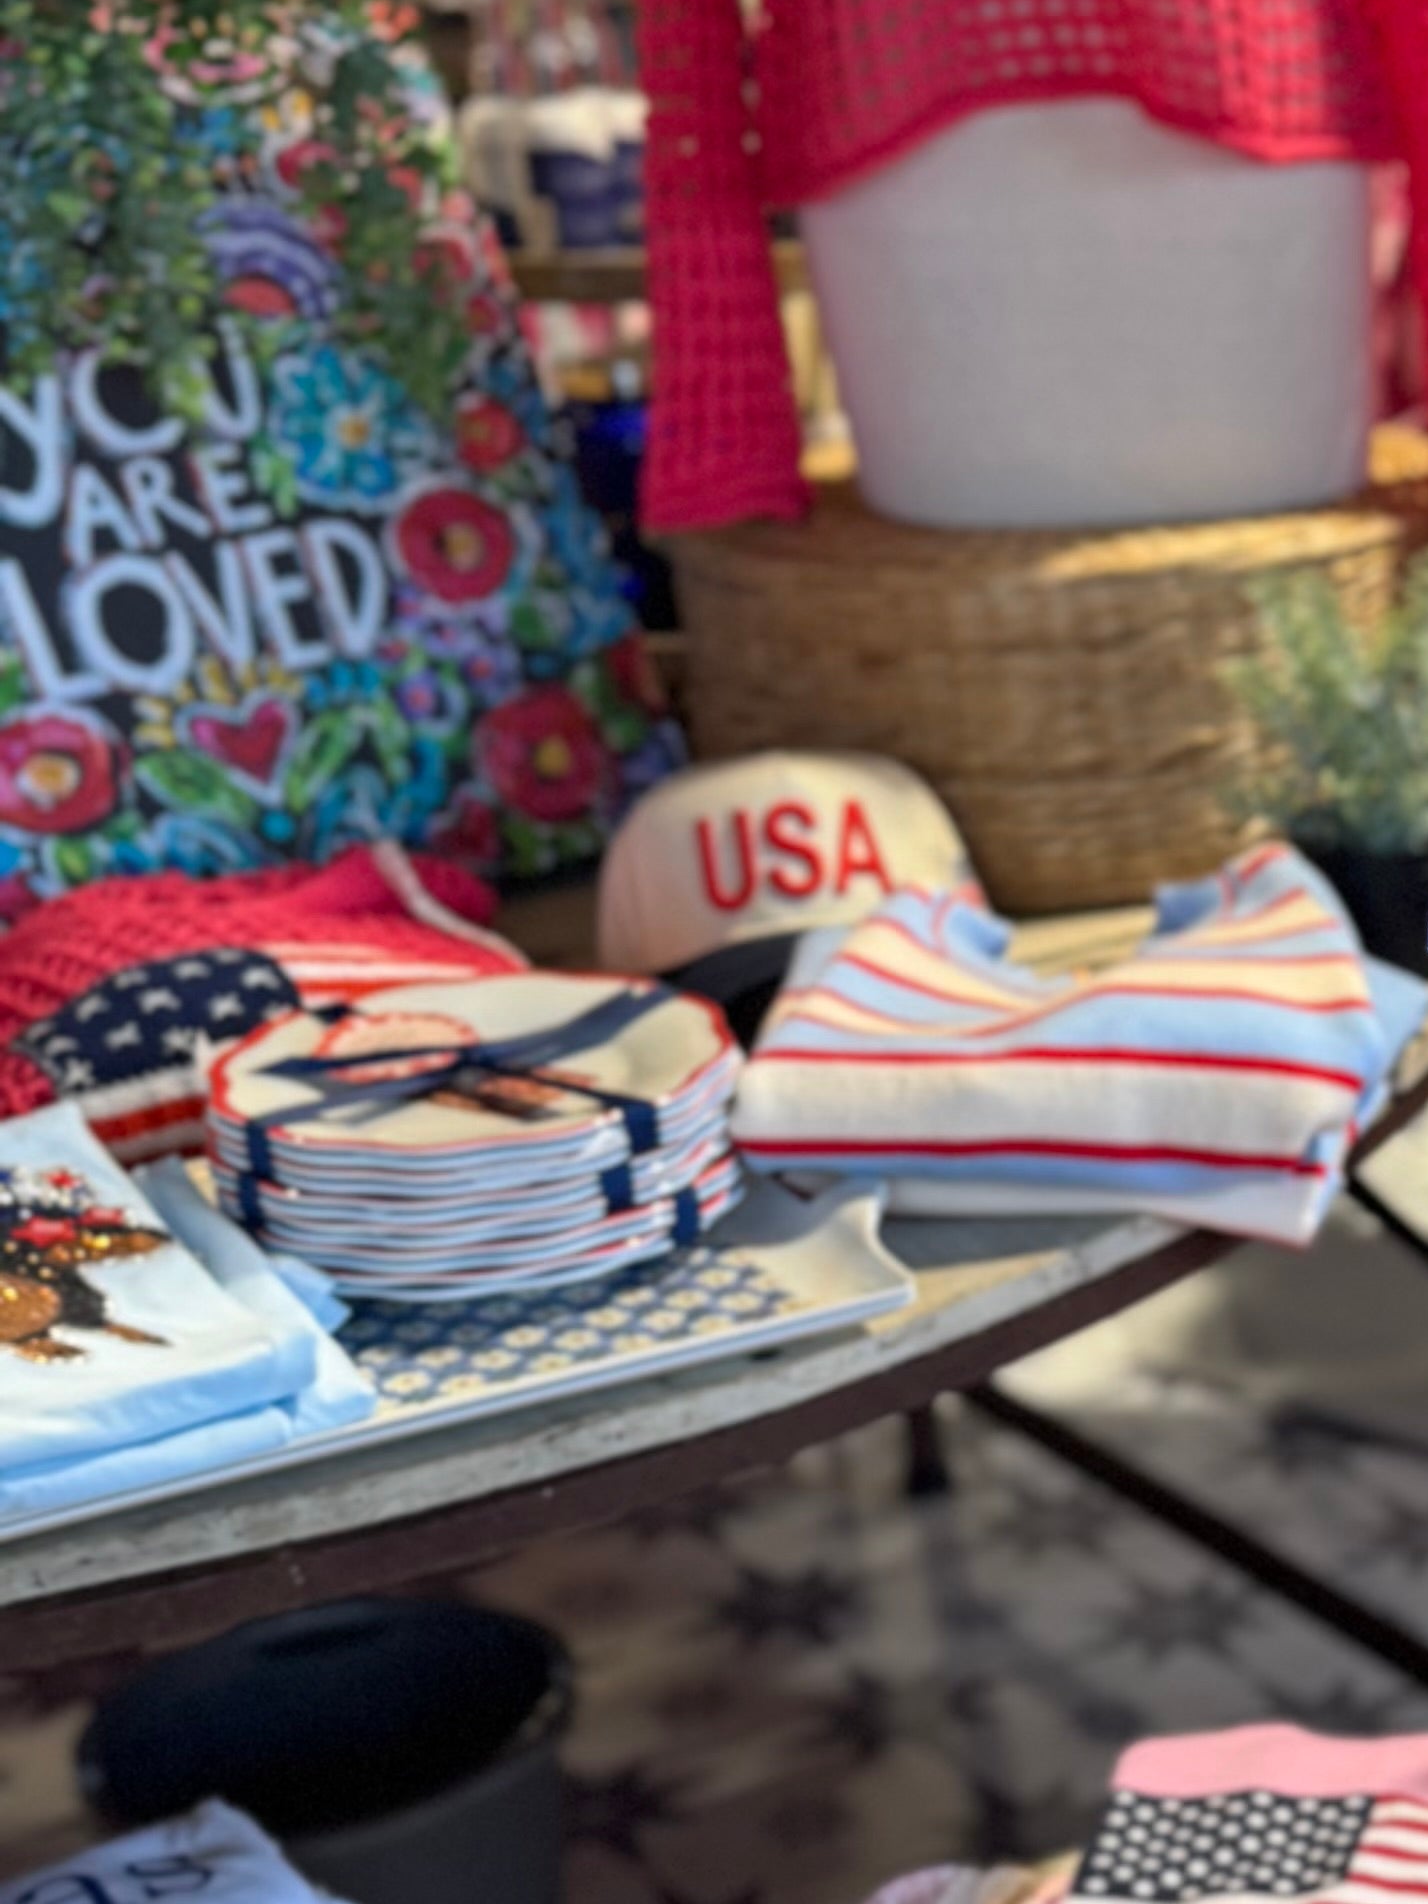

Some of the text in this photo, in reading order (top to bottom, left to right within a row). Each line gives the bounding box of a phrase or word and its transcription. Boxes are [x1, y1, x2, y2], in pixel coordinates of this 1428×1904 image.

[63, 442, 273, 568] ARE
[0, 517, 386, 706] LOVED
[693, 798, 893, 912] USA
